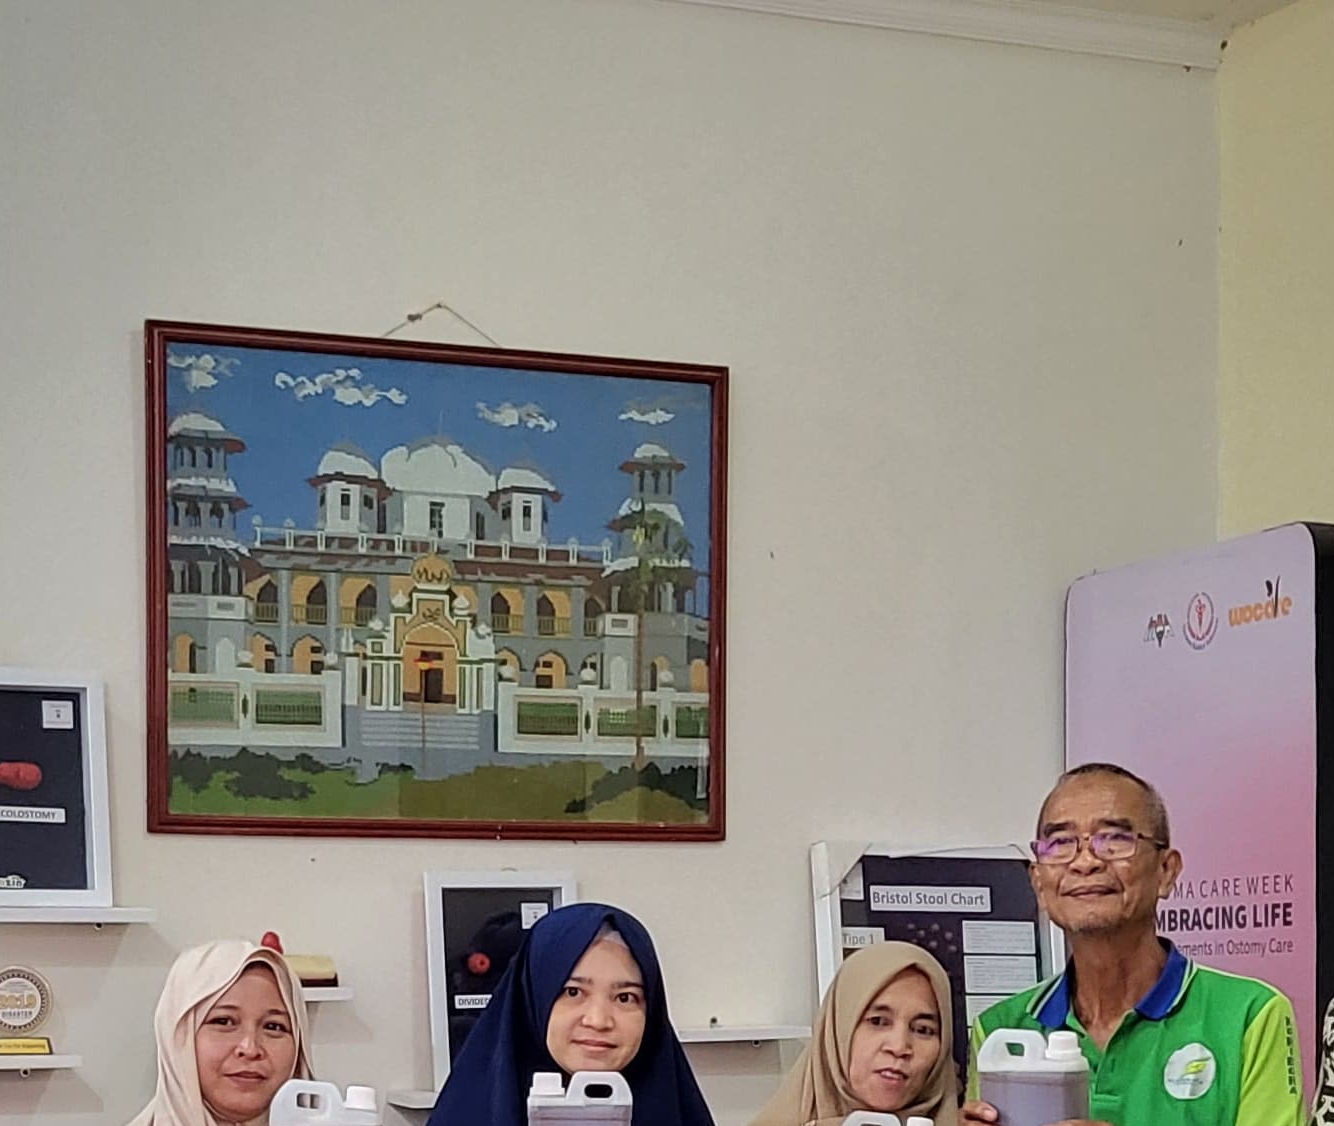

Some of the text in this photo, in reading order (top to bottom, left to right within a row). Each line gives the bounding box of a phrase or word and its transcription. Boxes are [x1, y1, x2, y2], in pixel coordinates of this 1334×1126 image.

[0, 810, 57, 820] COLOSTOMY
[1173, 873, 1294, 899] MA CARE WEEK
[872, 891, 985, 906] Bristol Stool Chart
[1155, 902, 1293, 932] MBRACING LIFE
[1215, 943, 1224, 955] in
[1227, 939, 1267, 957] Ostomy
[1269, 937, 1294, 953] Care
